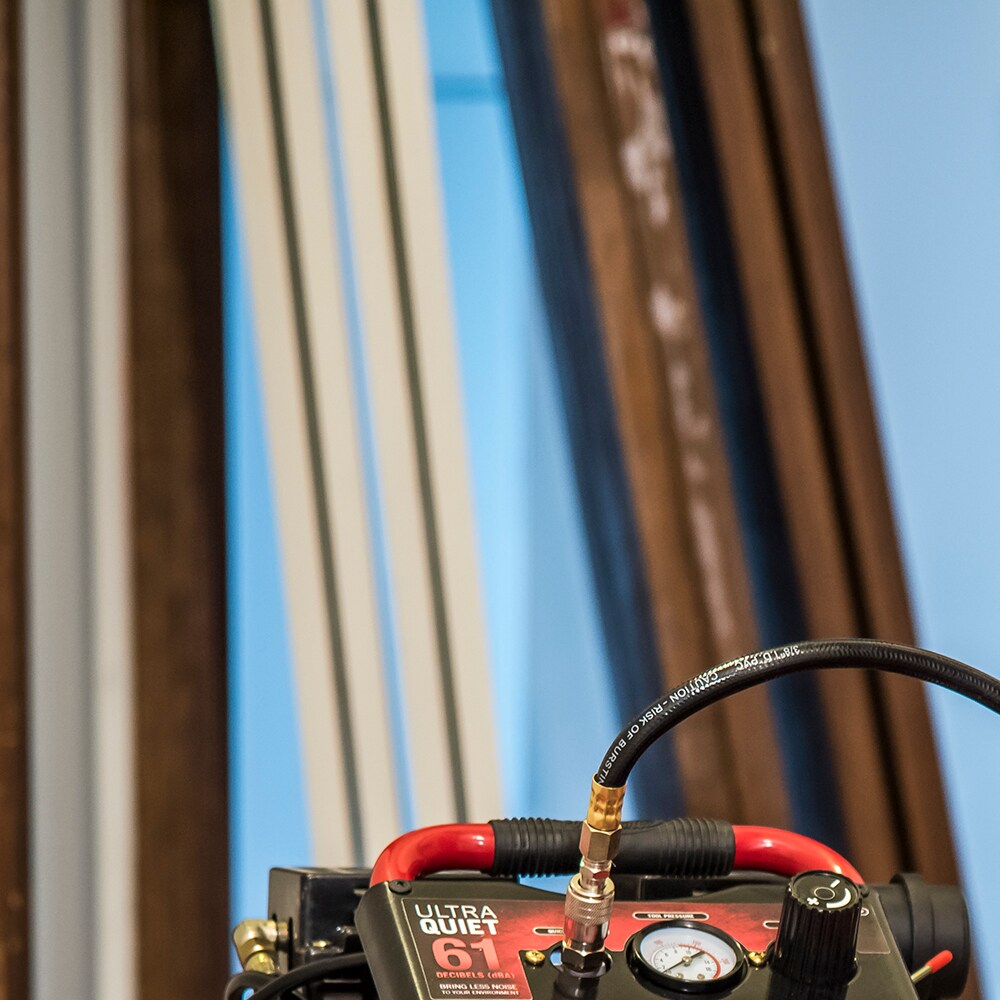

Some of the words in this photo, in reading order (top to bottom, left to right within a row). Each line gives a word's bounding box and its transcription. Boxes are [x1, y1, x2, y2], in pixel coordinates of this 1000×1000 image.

[669, 671, 719, 704] CAUTION
[638, 704, 664, 726] RISK
[626, 724, 640, 741] OF
[415, 904, 498, 919] ULTRA
[419, 918, 499, 935] QUIET
[432, 937, 501, 971] 61
